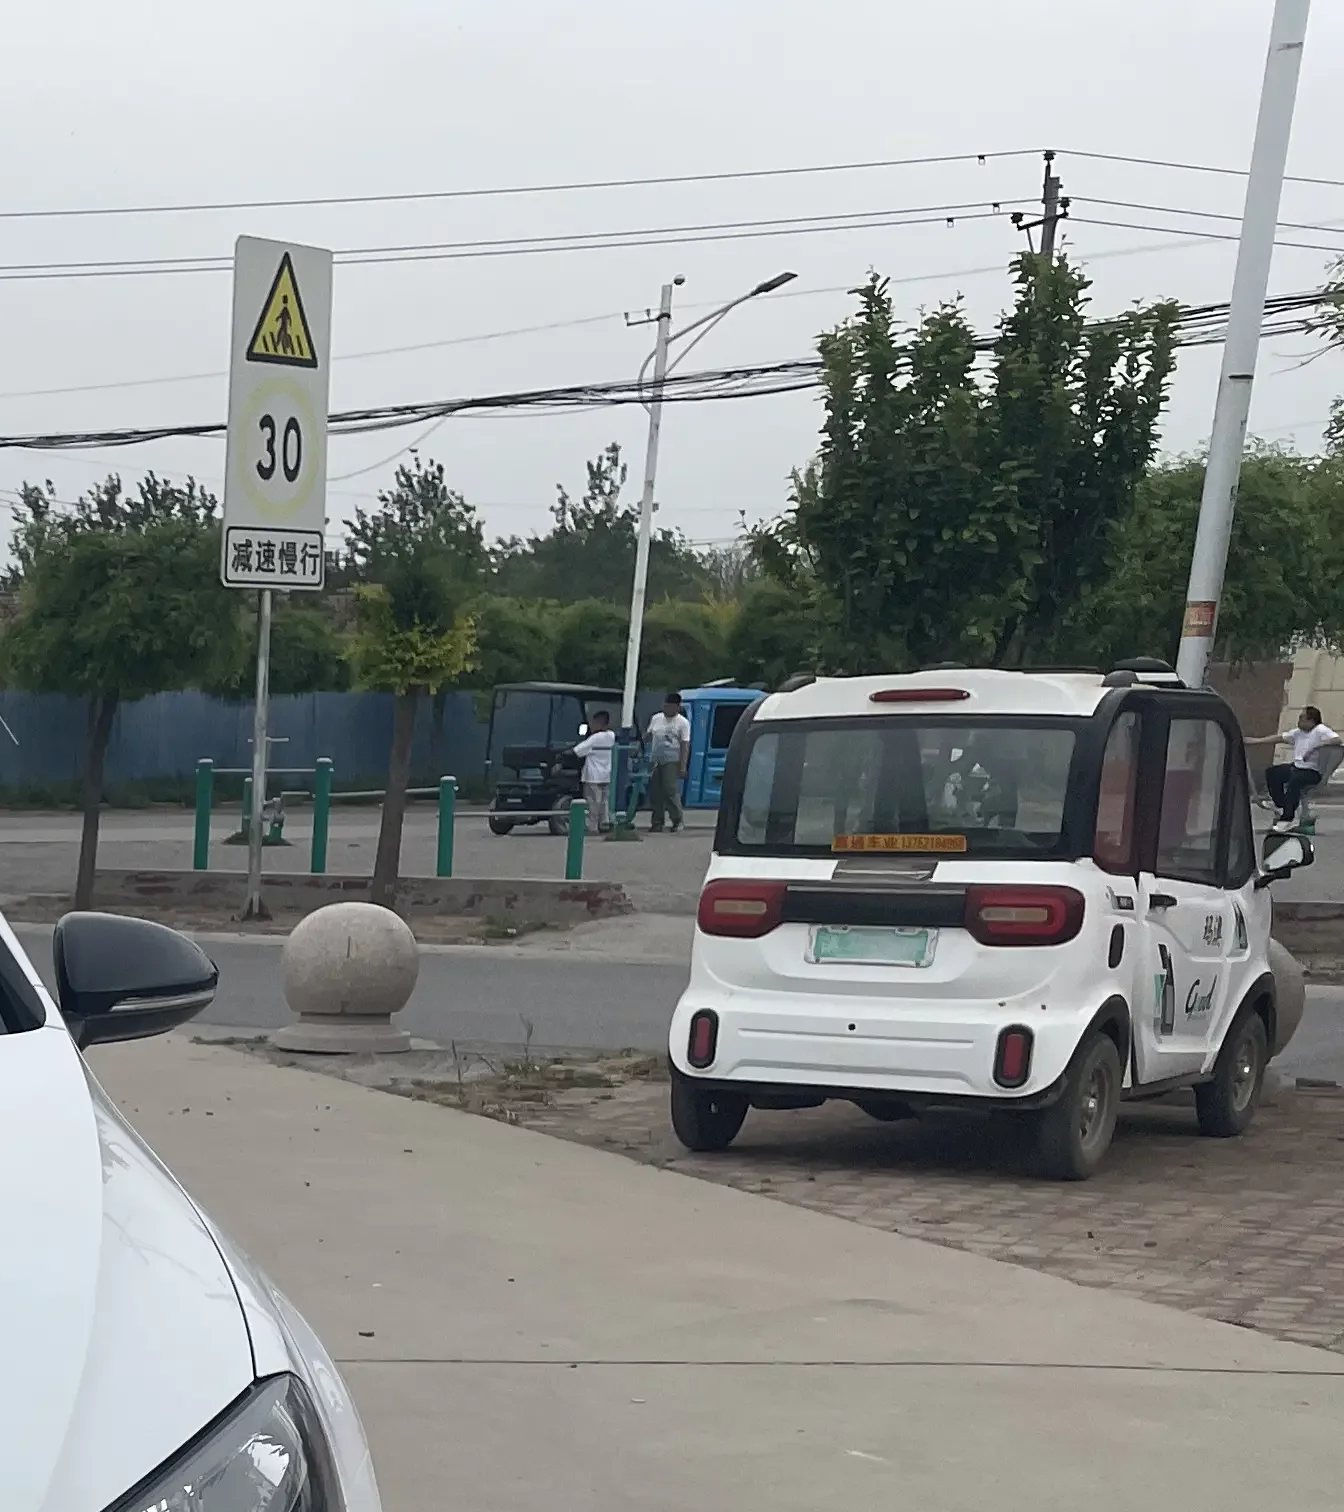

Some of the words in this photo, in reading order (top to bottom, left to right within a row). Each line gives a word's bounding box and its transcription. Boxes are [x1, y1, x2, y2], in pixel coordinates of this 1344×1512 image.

[256, 413, 302, 483] 30
[231, 538, 320, 577] 减速慢行
